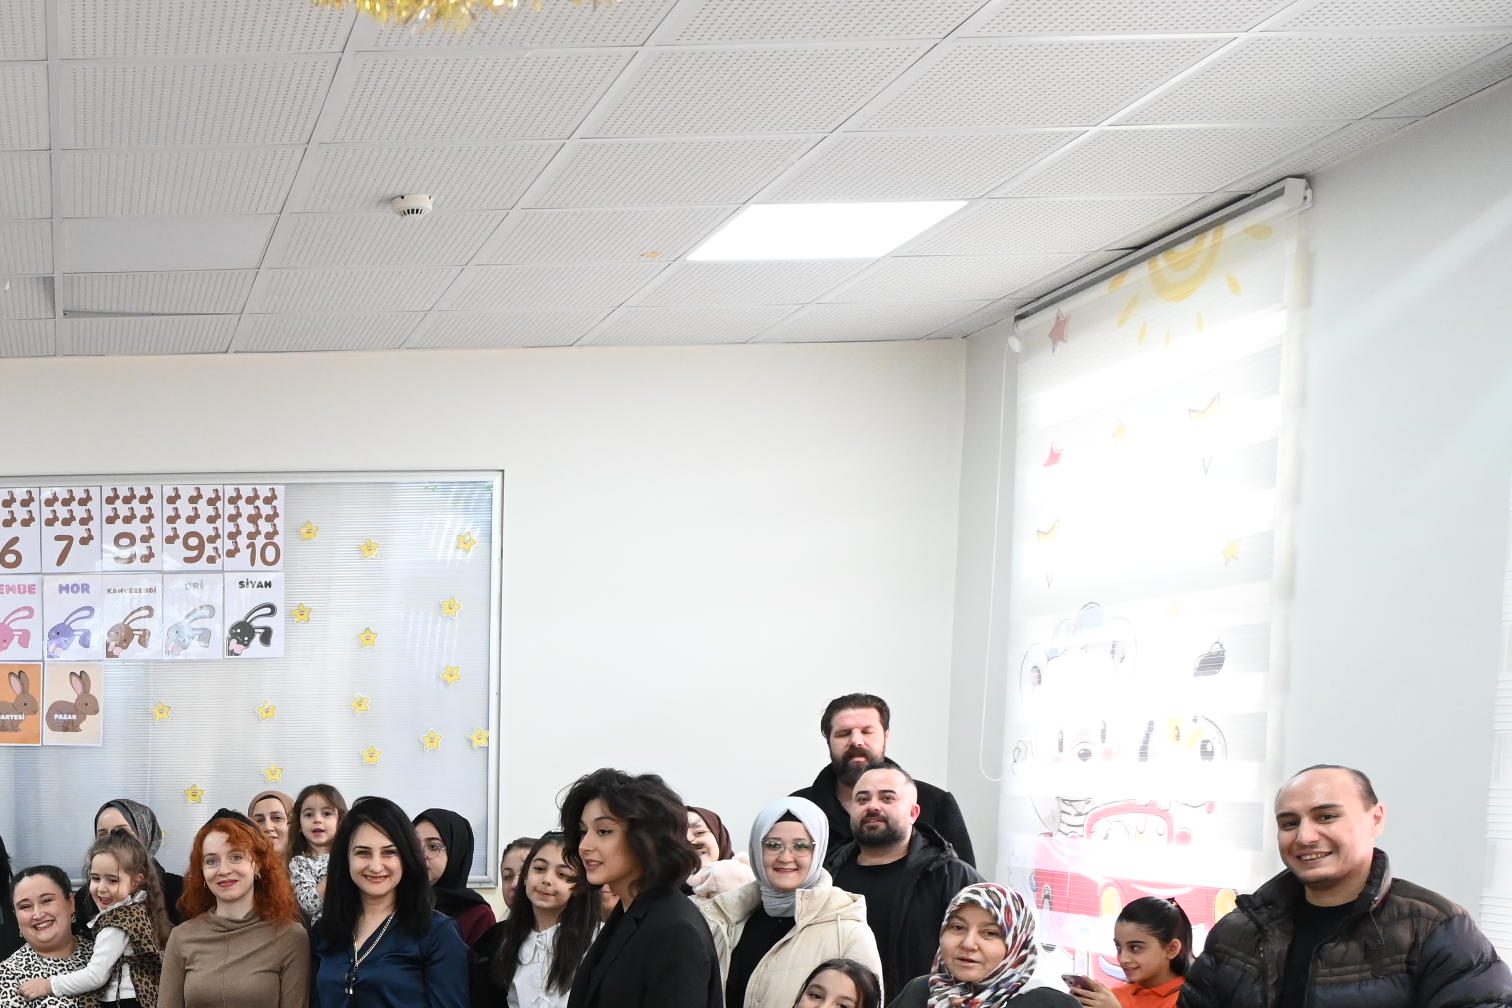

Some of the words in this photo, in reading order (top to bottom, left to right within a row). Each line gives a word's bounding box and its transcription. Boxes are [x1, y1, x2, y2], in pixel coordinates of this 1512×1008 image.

[0, 536, 23, 569] 6
[54, 534, 74, 567] 7
[113, 531, 137, 564] 8
[182, 531, 205, 564] 9
[246, 541, 281, 567] 10
[58, 583, 91, 594] MOR
[238, 578, 272, 589] SİYAH
